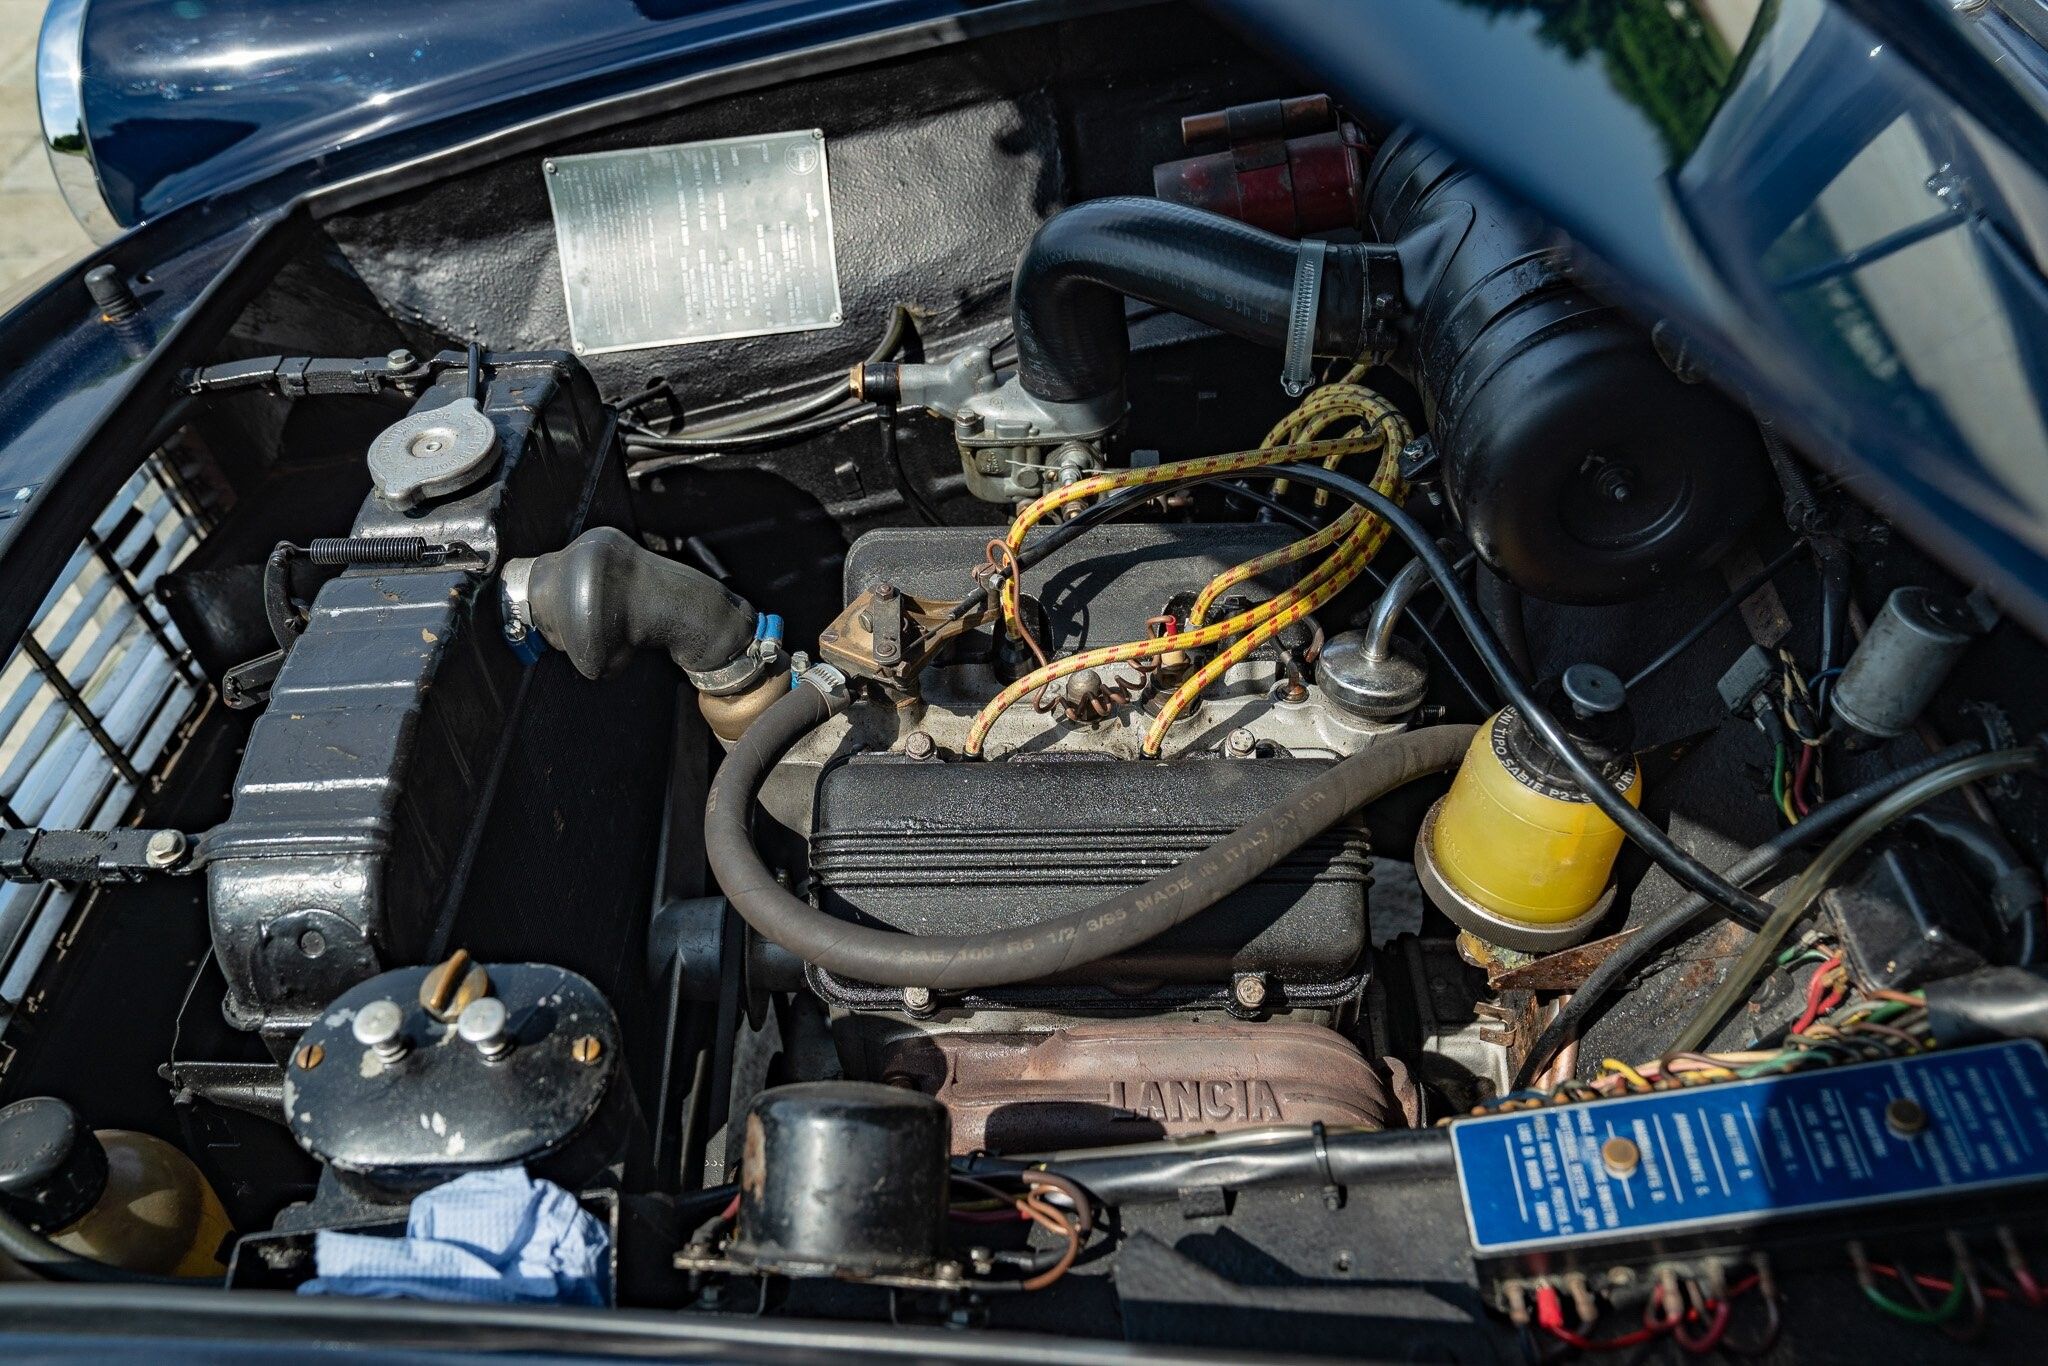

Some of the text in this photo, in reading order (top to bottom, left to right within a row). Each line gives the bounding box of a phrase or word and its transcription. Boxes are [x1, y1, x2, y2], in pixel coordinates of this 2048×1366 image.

[1492, 728, 1508, 755] TIPO
[1135, 875, 1194, 913] MADE
[1199, 861, 1219, 879] IN
[1224, 830, 1269, 864] ITALY
[1110, 1080, 1285, 1122] LANCIA
